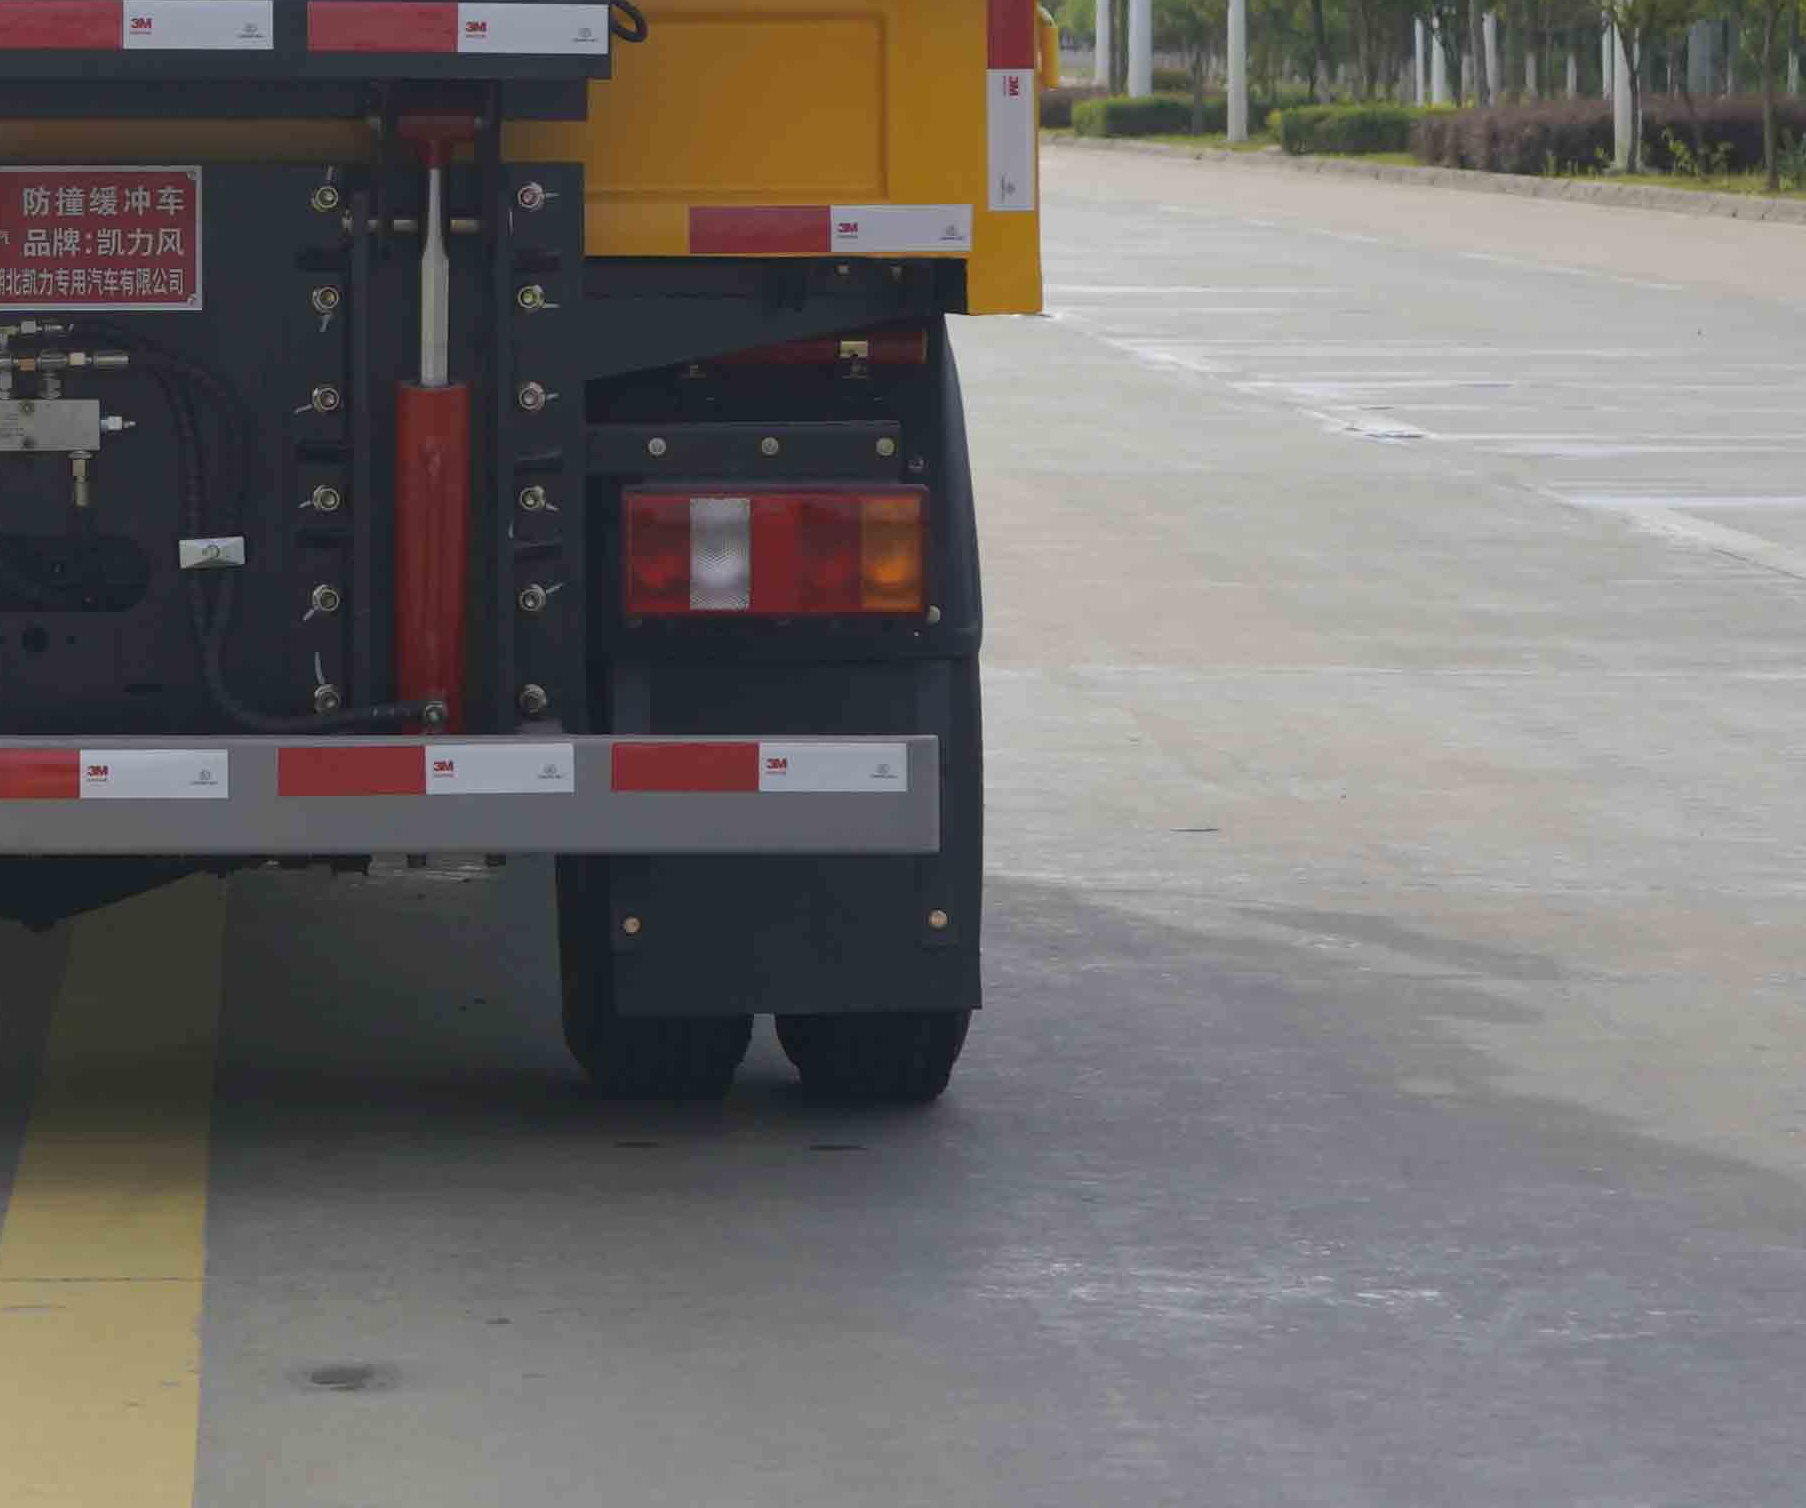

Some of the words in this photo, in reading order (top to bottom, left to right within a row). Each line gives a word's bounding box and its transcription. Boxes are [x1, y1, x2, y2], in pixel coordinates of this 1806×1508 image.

[129, 16, 153, 31] 3M
[465, 20, 488, 33] 3M
[1008, 75, 1019, 98] 3M
[22, 186, 185, 217] 防撞缓冲车
[836, 222, 859, 234] 3M
[23, 227, 185, 257] 品牌:凯力风
[432, 759, 455, 773] 3M
[766, 757, 788, 770] 3M
[87, 764, 110, 778] 3M
